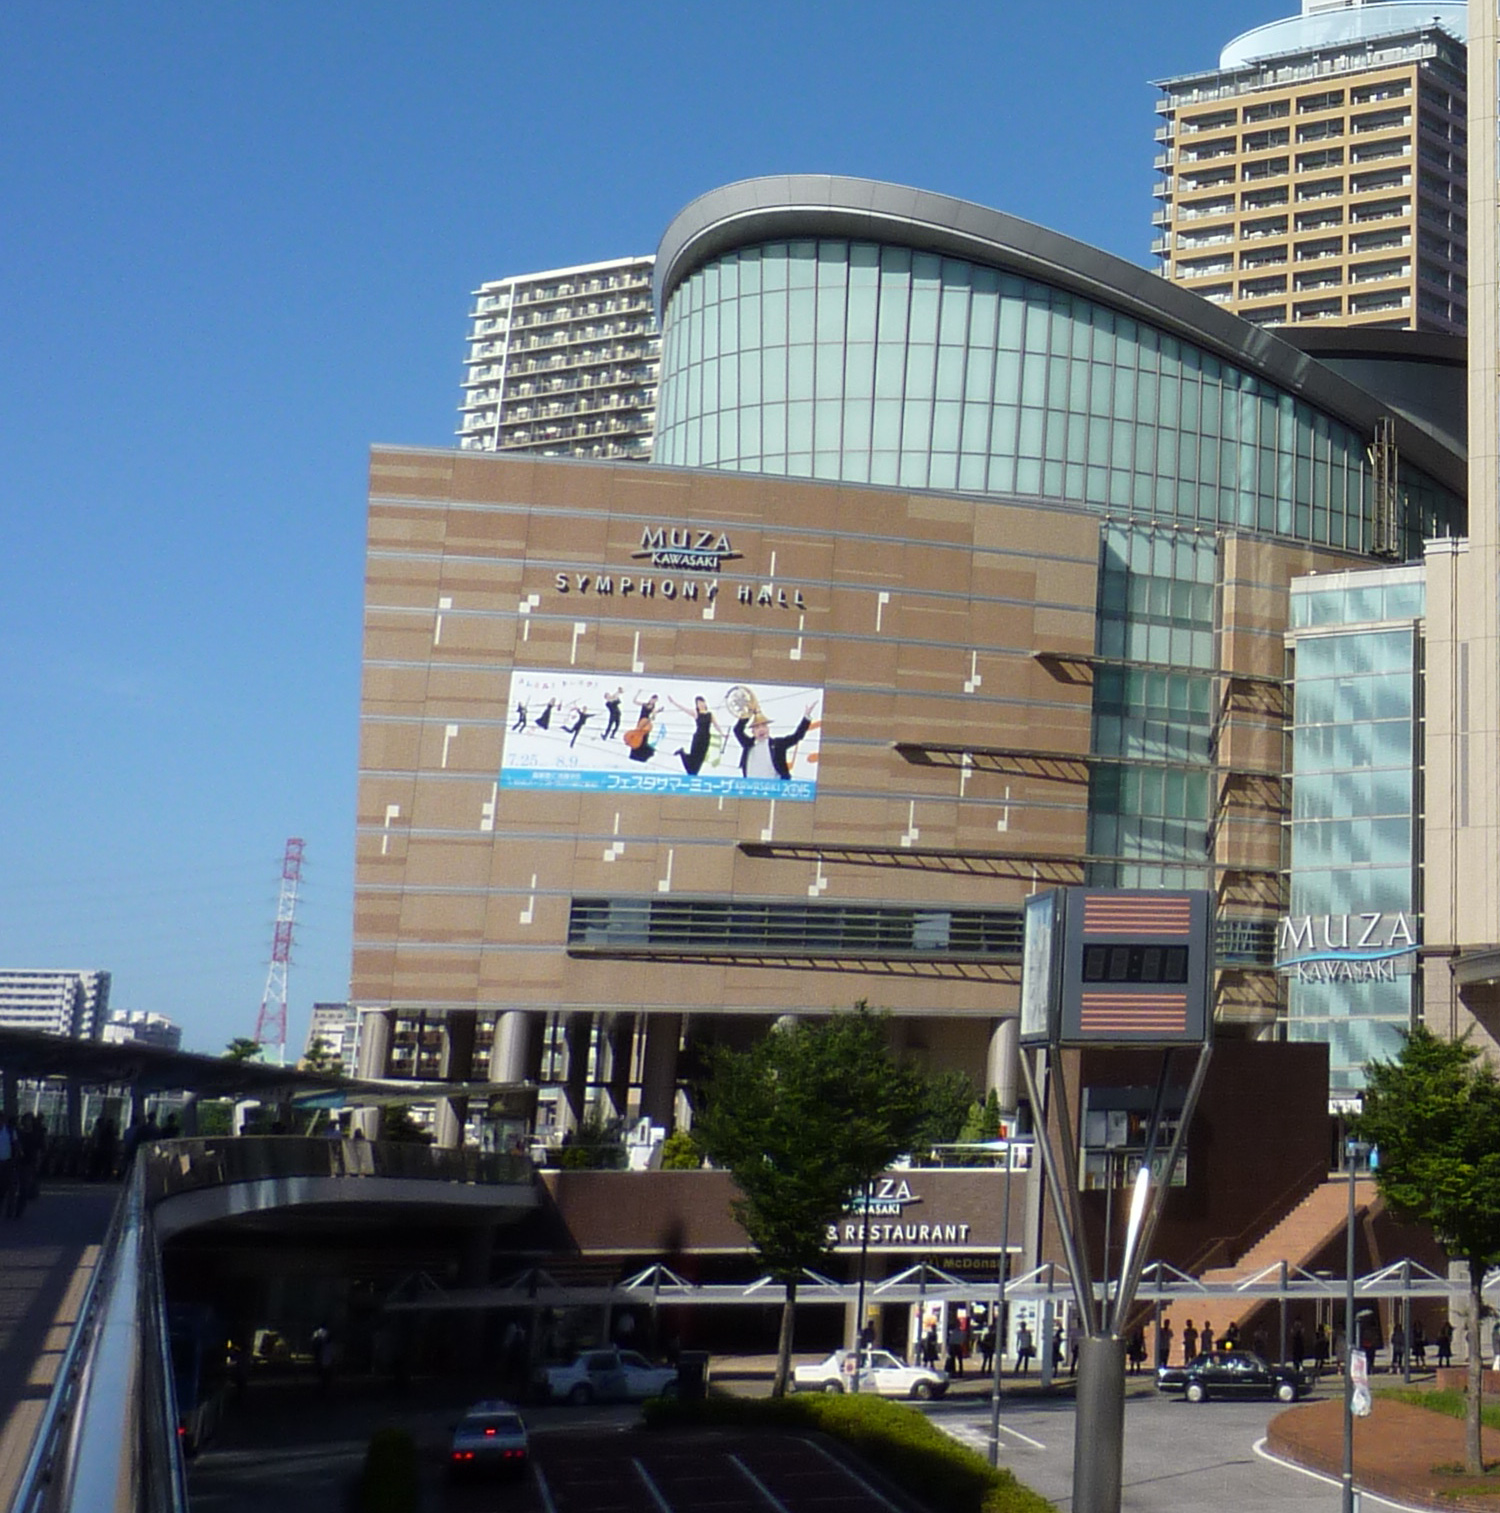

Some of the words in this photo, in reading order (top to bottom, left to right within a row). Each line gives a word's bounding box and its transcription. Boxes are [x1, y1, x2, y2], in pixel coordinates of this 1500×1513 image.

[640, 526, 731, 550] MUZA
[652, 553, 718, 567] KAWASAKI
[555, 573, 717, 597] SYMPHONY
[737, 585, 804, 604] HALL
[608, 774, 734, 793] フェスタサマーミューザ
[1280, 911, 1417, 949] MUZA
[1297, 960, 1396, 982] KAWASAKI
[826, 1226, 838, 1240] &
[845, 1225, 970, 1240] RESTAURANT
